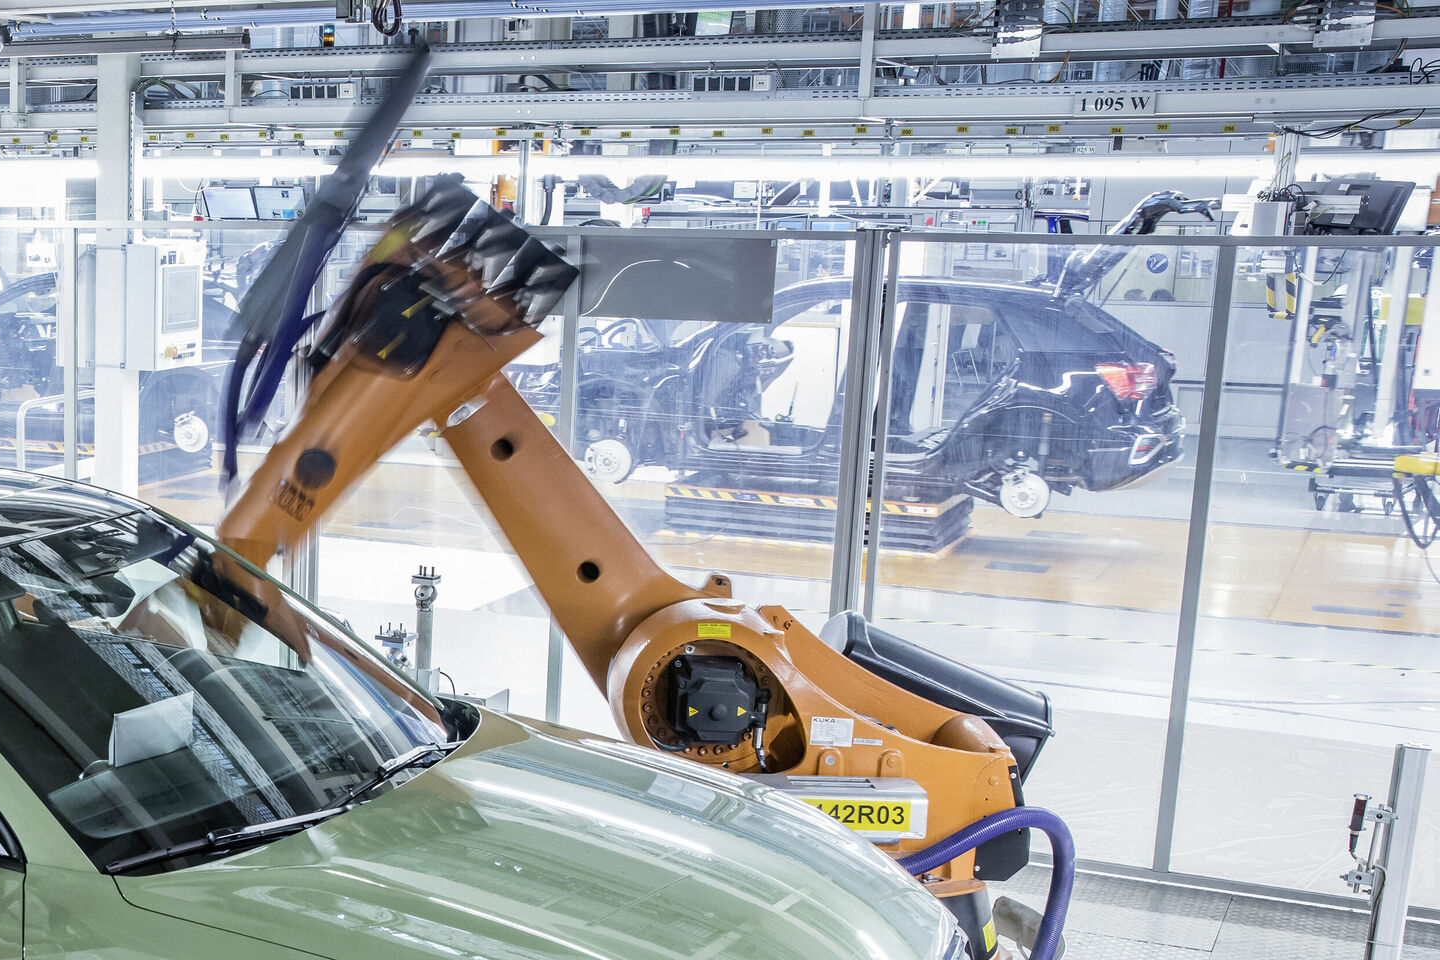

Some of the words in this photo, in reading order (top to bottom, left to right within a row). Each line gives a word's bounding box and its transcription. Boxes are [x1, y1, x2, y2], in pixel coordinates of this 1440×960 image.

[1080, 97, 1088, 112] 1
[1094, 96, 1125, 112] 095
[1130, 95, 1151, 111] W
